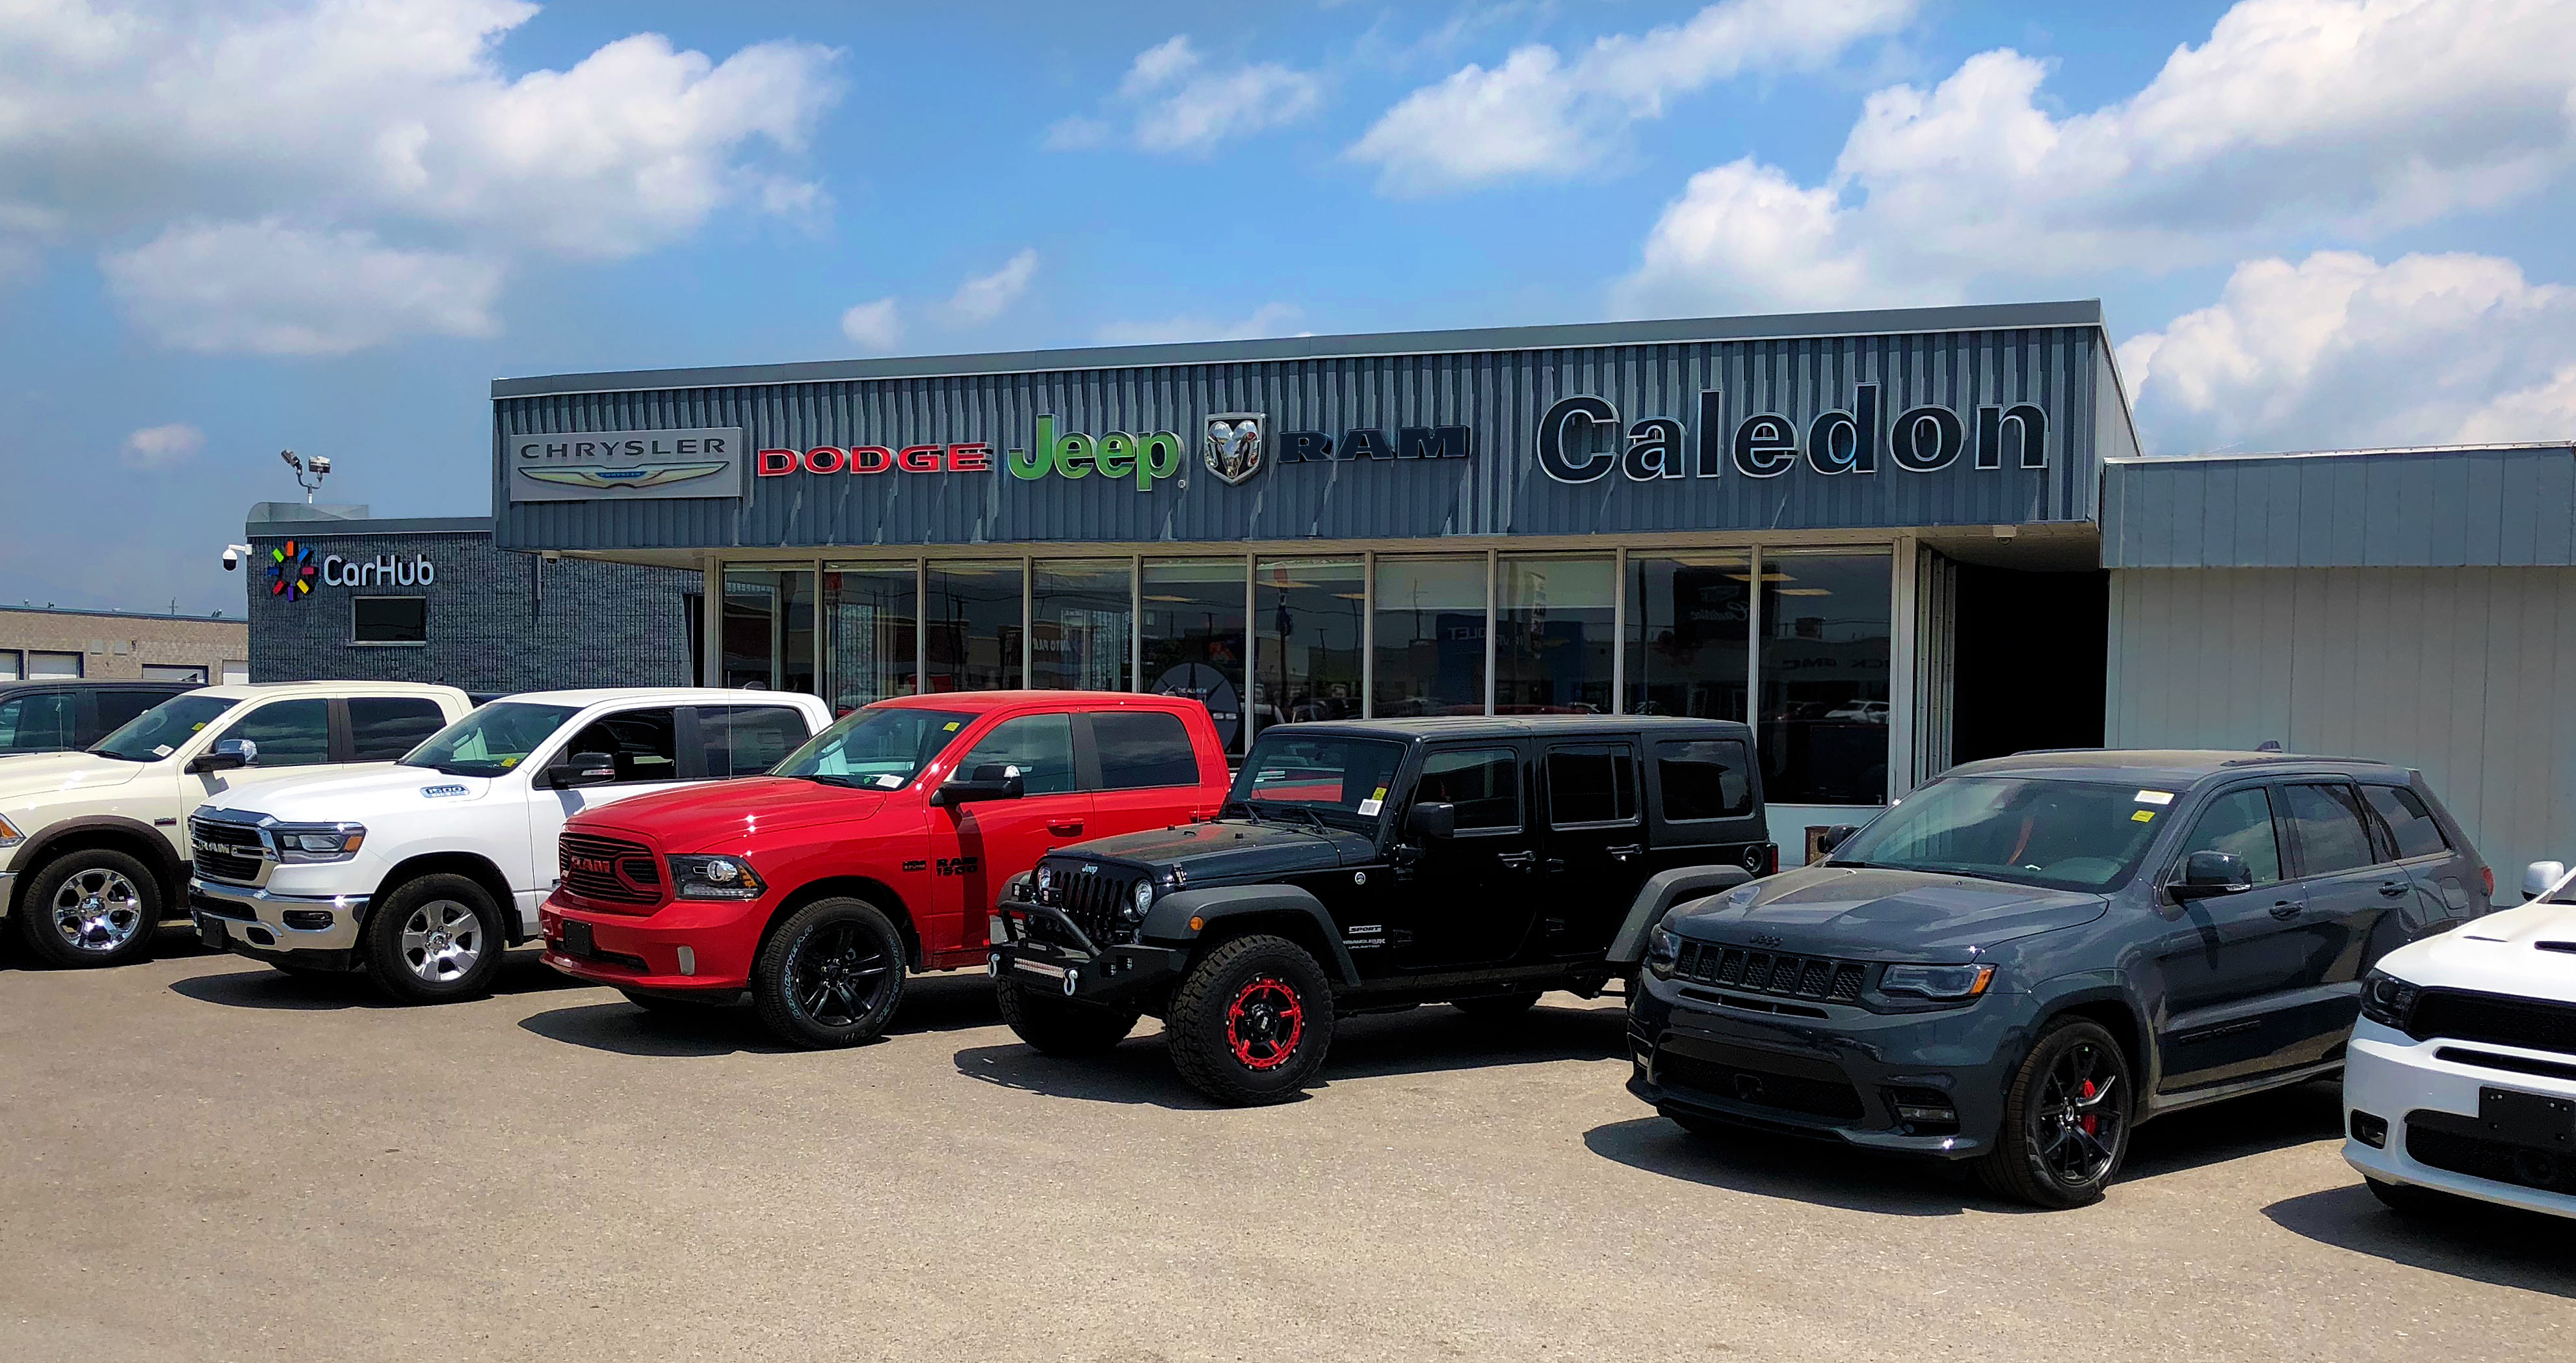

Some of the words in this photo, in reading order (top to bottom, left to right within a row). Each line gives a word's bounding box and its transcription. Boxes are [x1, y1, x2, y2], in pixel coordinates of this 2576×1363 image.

[521, 438, 726, 460] CHRYSLER
[1278, 425, 1469, 463] RAM
[1536, 382, 2050, 484] Caledon
[757, 442, 992, 477] DODGE
[1007, 414, 1185, 492] Jeep
[324, 553, 434, 587] CarHub
[198, 839, 230, 854] RAM
[936, 856, 978, 867] RAM
[571, 855, 611, 874] RAM
[937, 865, 978, 877] 1500
[1081, 863, 1098, 875] Jeep
[784, 924, 813, 1020] GOODYEAR
[875, 933, 902, 1024] WRANGLER
